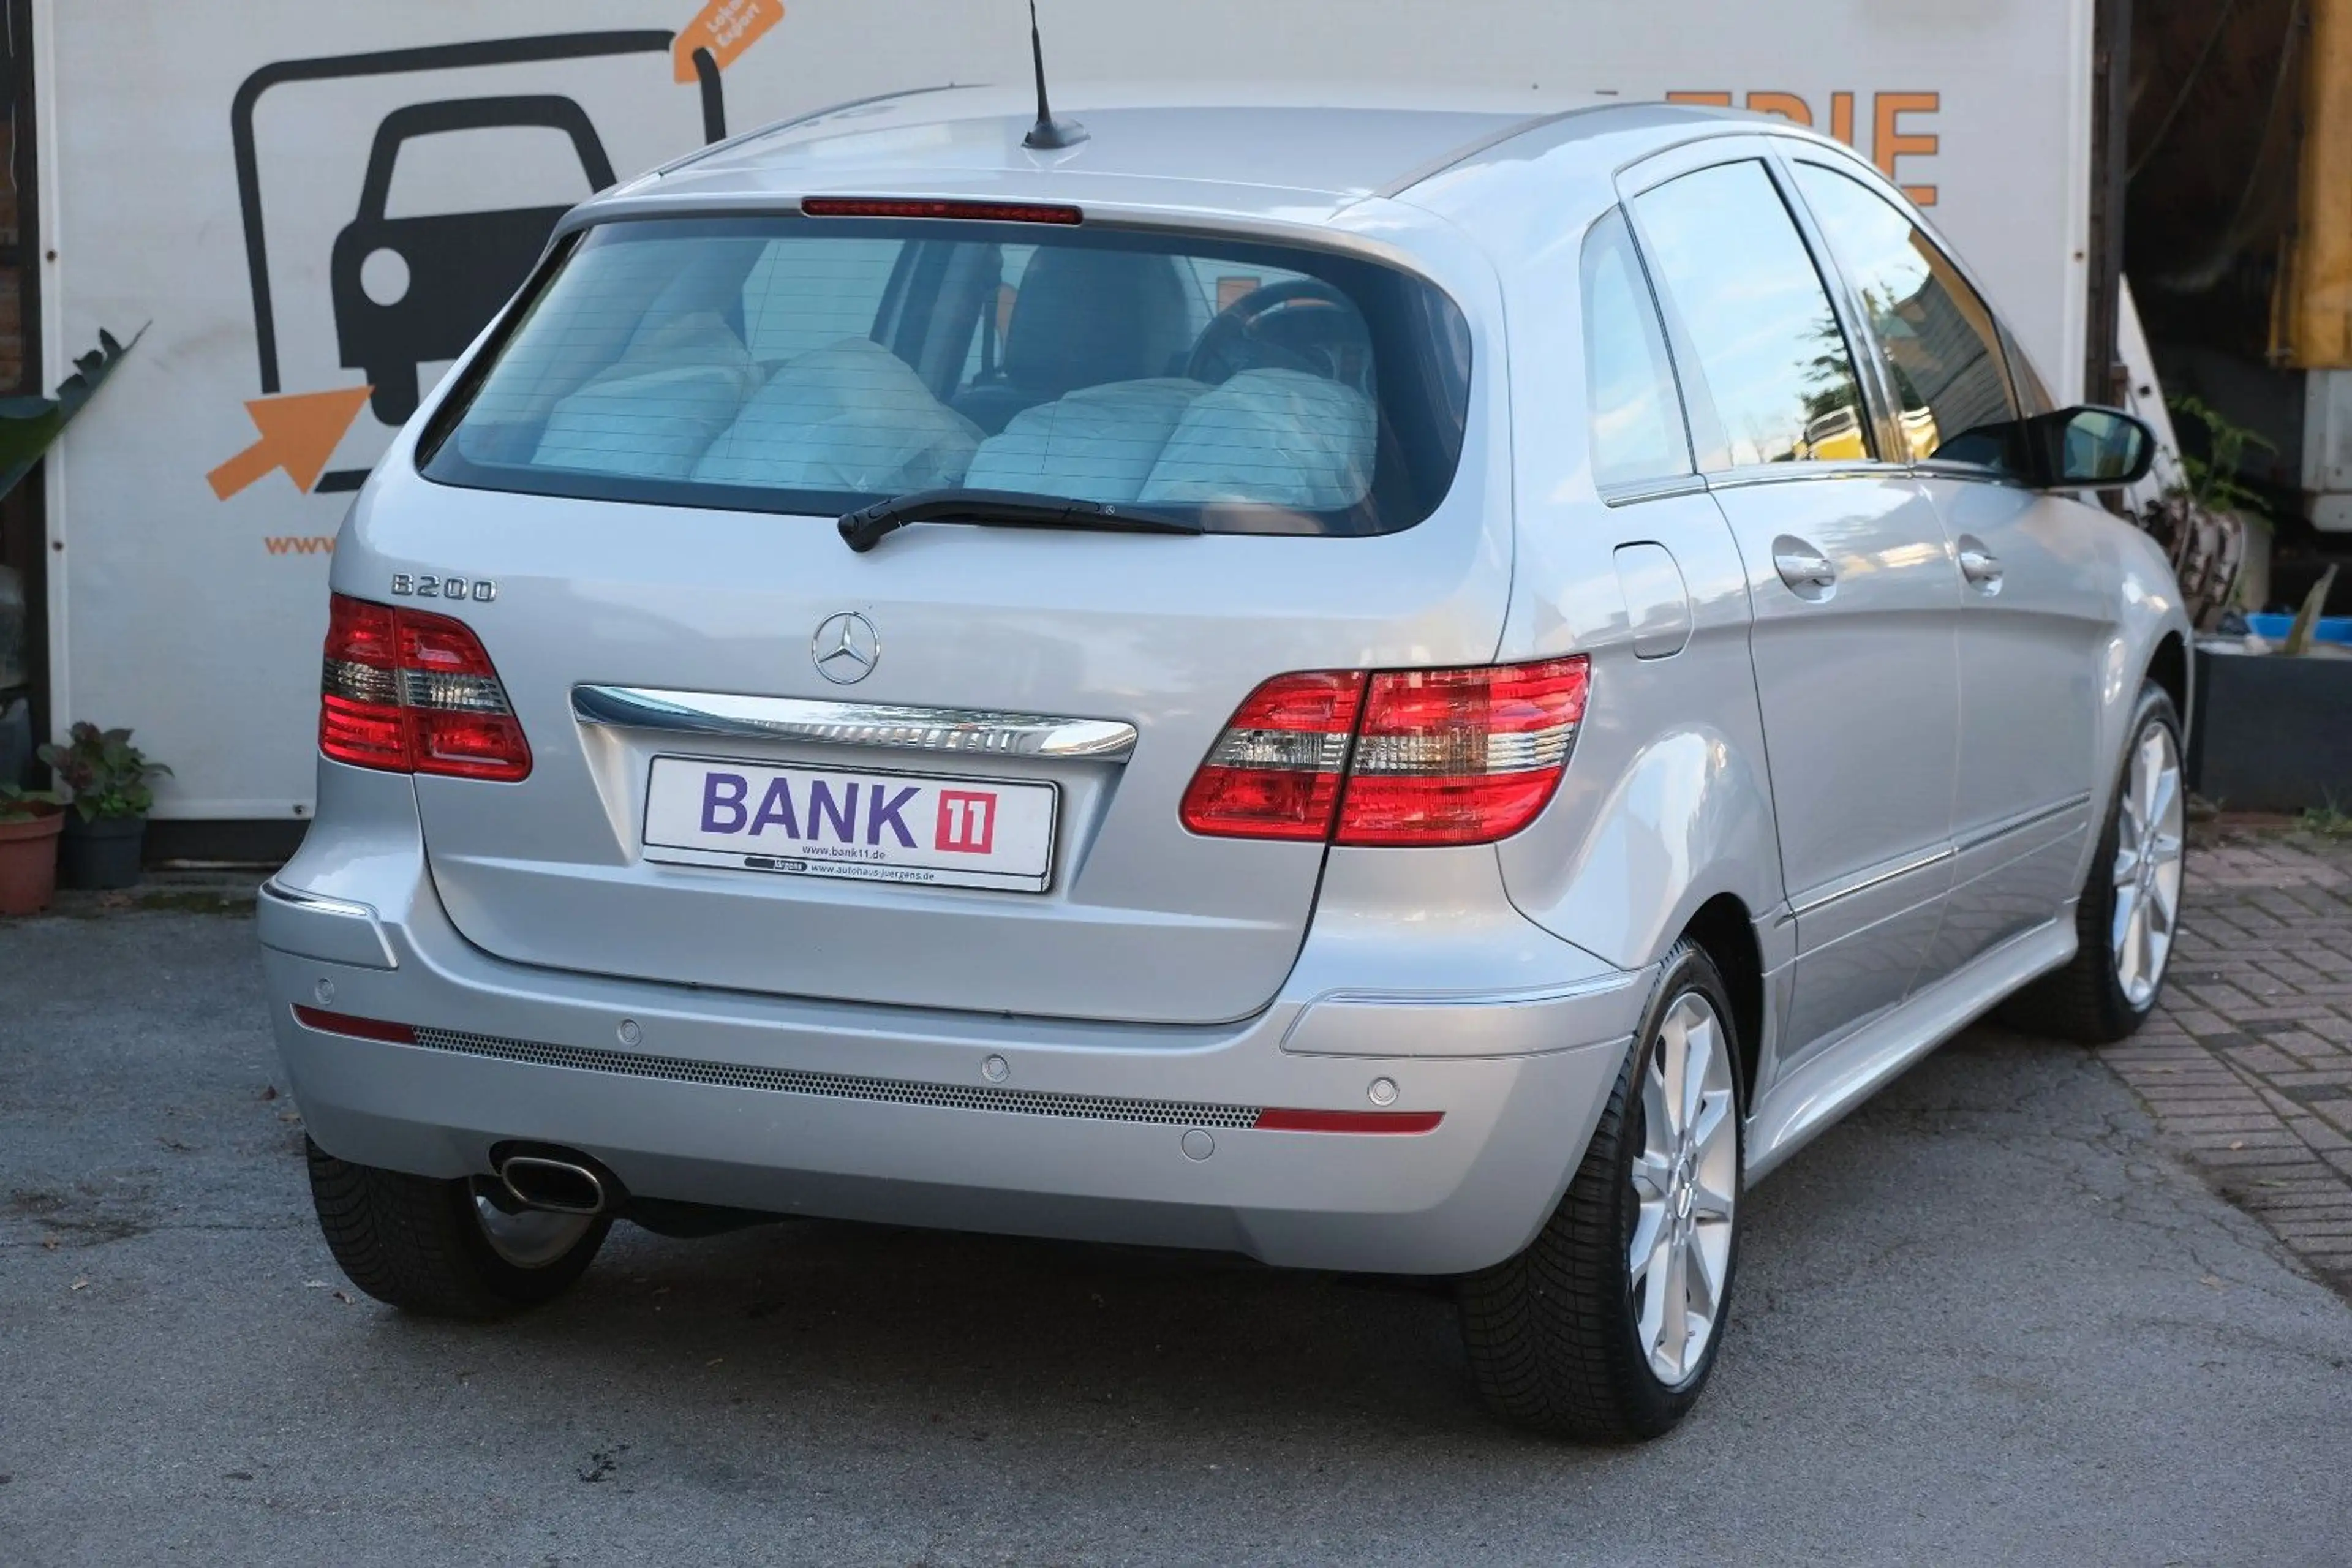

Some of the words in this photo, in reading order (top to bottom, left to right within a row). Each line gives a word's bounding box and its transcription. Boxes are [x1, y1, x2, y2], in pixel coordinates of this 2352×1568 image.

[390, 572, 498, 603] B200
[700, 772, 921, 849] BANK
[944, 797, 990, 848] 11
[802, 845, 886, 860] www.bank11.de
